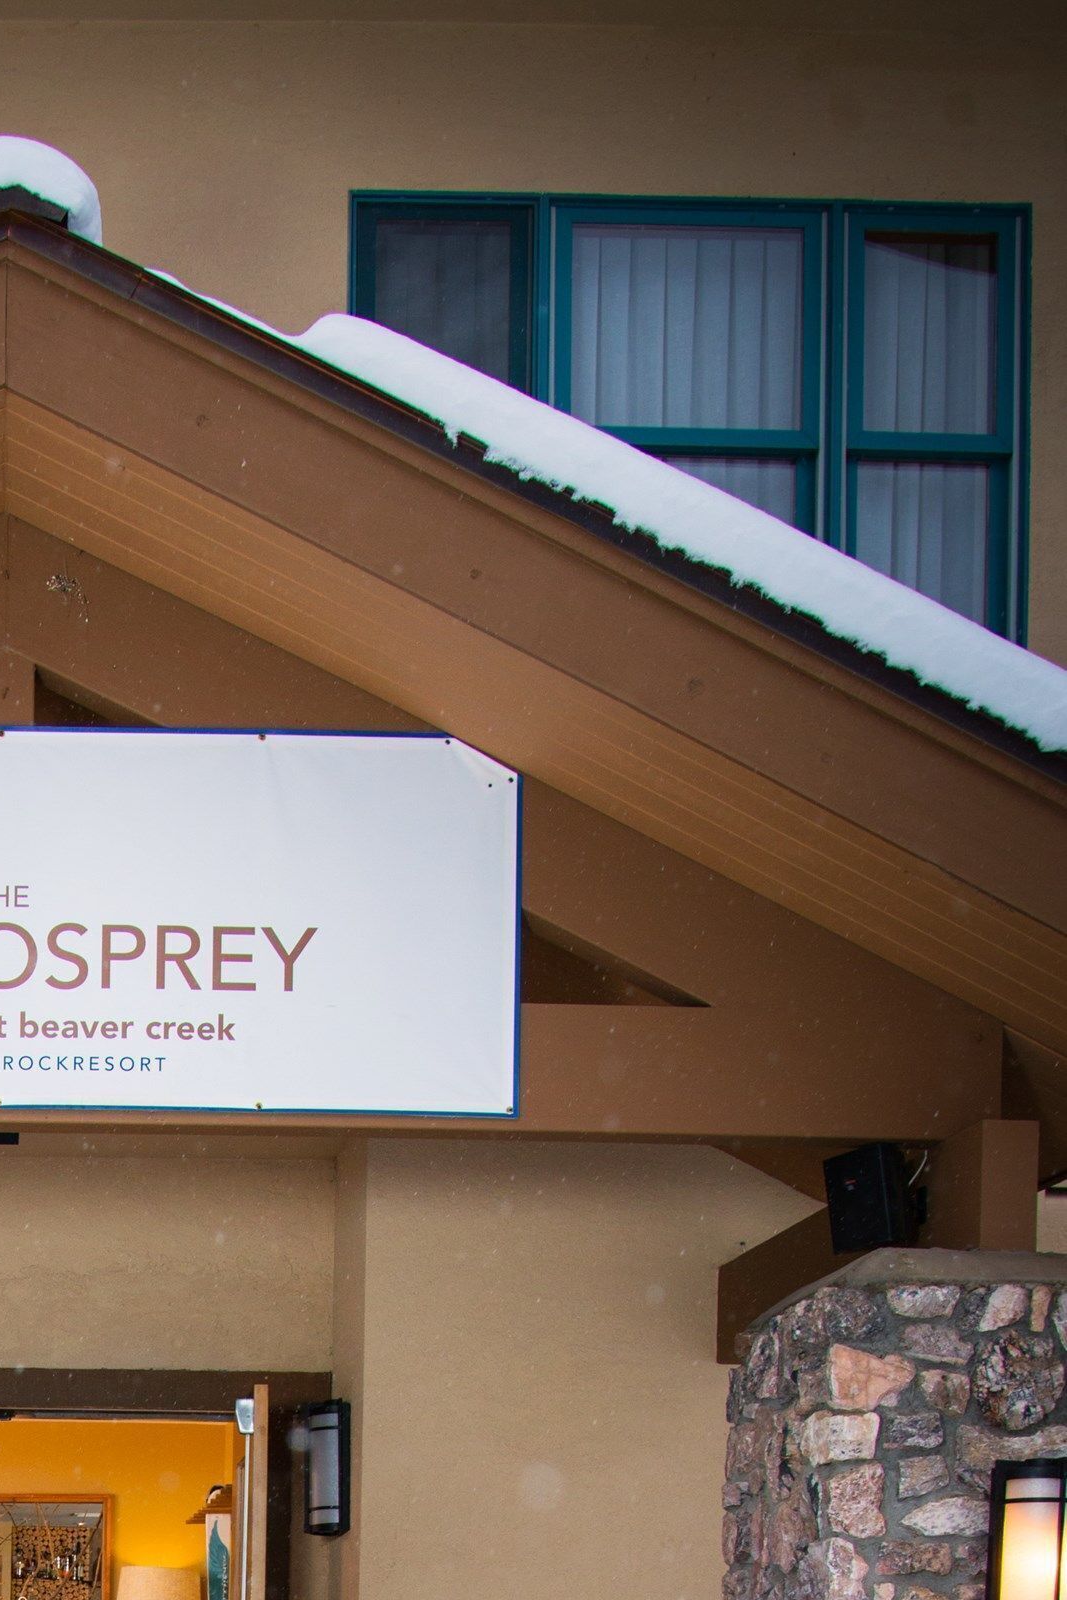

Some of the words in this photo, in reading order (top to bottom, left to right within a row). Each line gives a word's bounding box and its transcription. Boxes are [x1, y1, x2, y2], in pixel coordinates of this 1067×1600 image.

[19, 1010, 134, 1039] beaver
[145, 1013, 235, 1040] creek
[2, 1055, 166, 1071] ROCKRESORT
